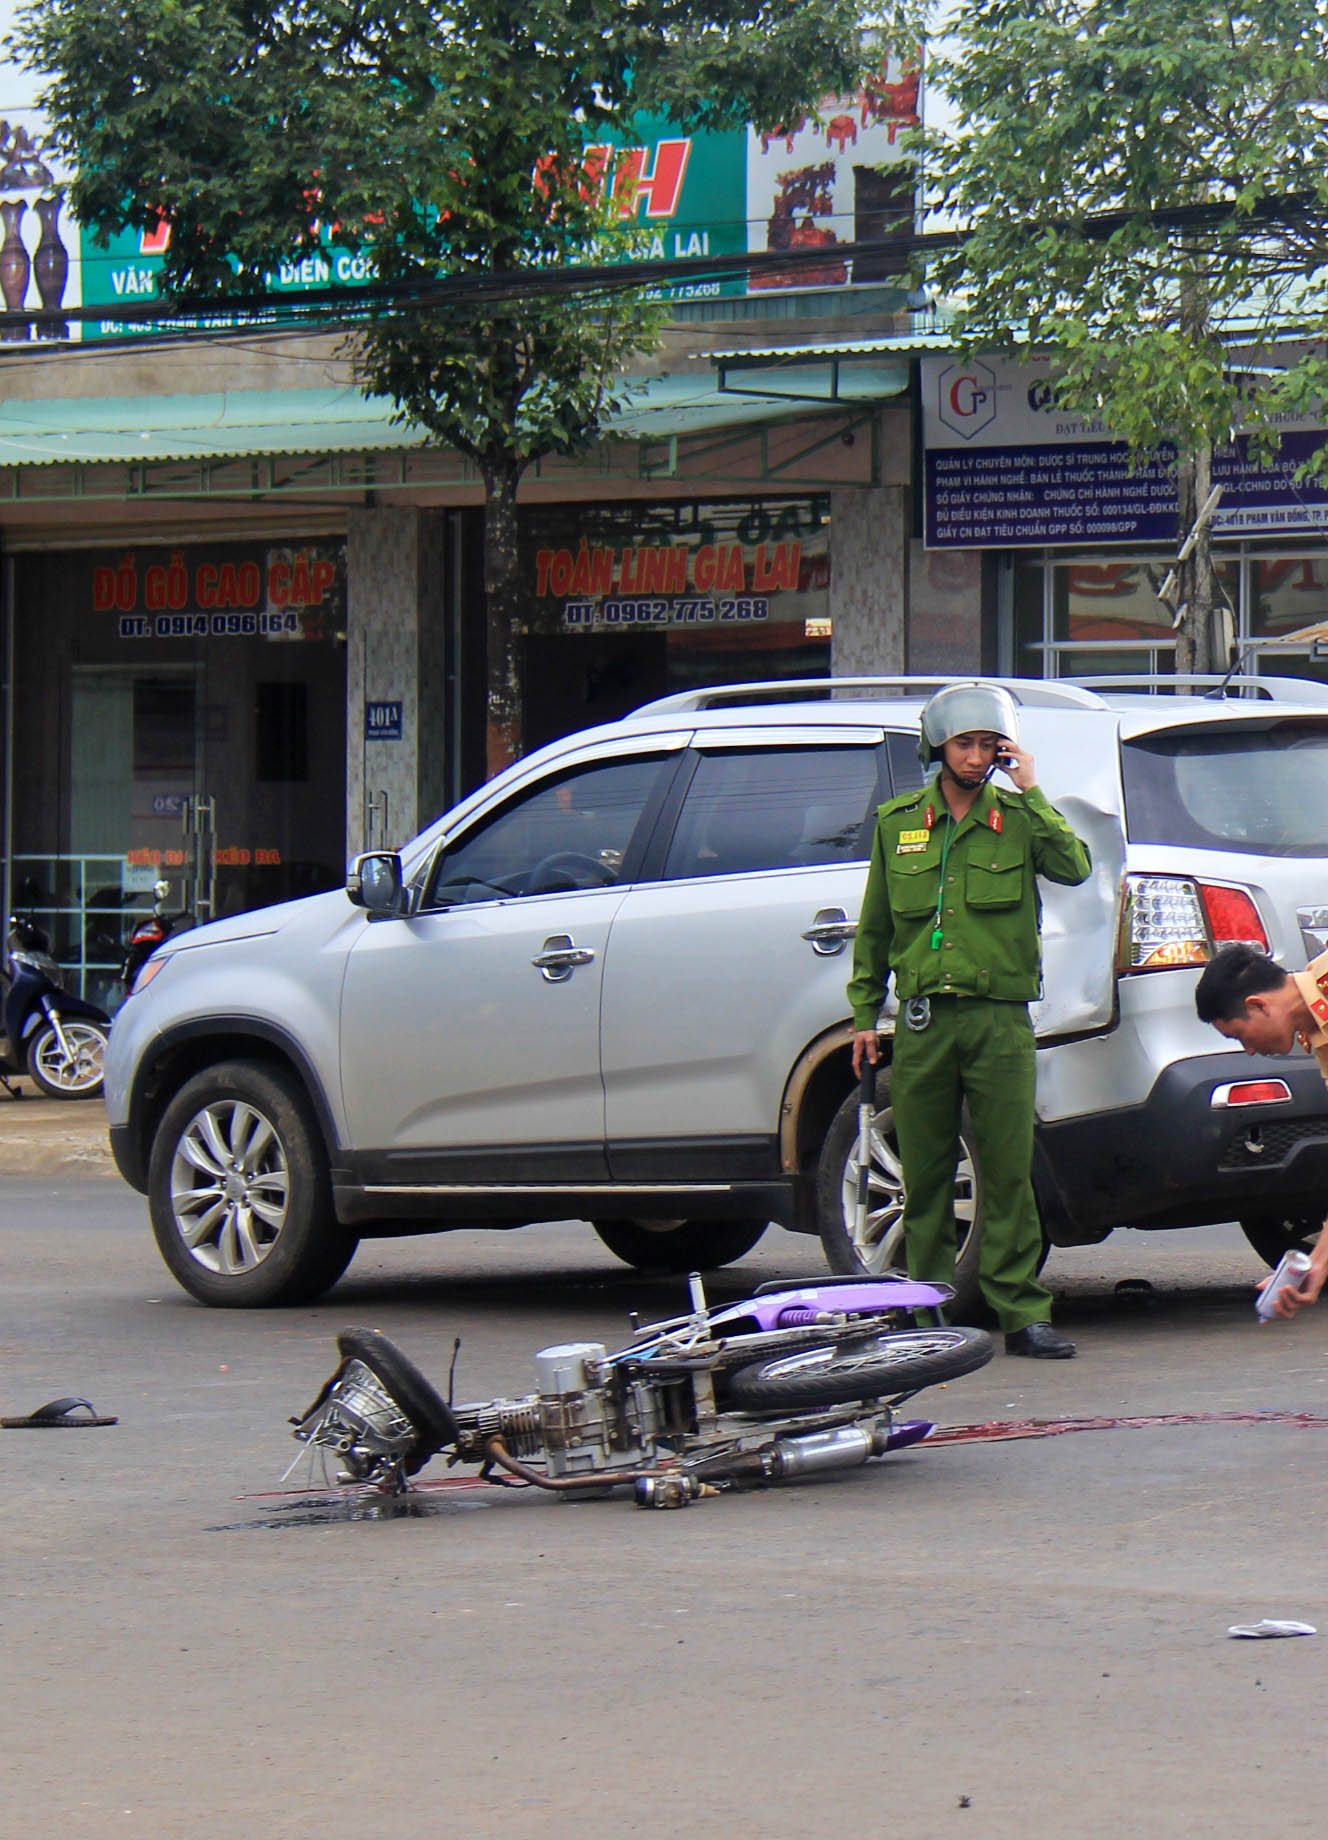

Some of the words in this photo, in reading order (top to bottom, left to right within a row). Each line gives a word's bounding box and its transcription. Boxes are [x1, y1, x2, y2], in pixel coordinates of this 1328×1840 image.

[674, 231, 709, 258] LAI
[111, 267, 153, 295] VĂN
[976, 455, 1012, 469] CHUYÊN
[1077, 453, 1107, 465] TRUNG
[1064, 466, 1095, 482] THUỐC
[997, 508, 1017, 520] KINH
[1019, 507, 1051, 519] DOANH
[1053, 503, 1083, 517] THUỐC
[994, 523, 1014, 537] TIÊU
[1048, 523, 1068, 535] GPP
[145, 550, 188, 609] GỖ
[196, 562, 260, 608] CAO
[267, 550, 335, 607] CẤP
[619, 546, 690, 595] LINH
[694, 544, 745, 593] GIA
[752, 543, 801, 591] LAI
[604, 600, 668, 623] 0962
[671, 600, 715, 622] 775
[719, 599, 768, 620] 268
[156, 613, 208, 637] 0914
[212, 612, 257, 636] 096
[261, 611, 299, 635] 164
